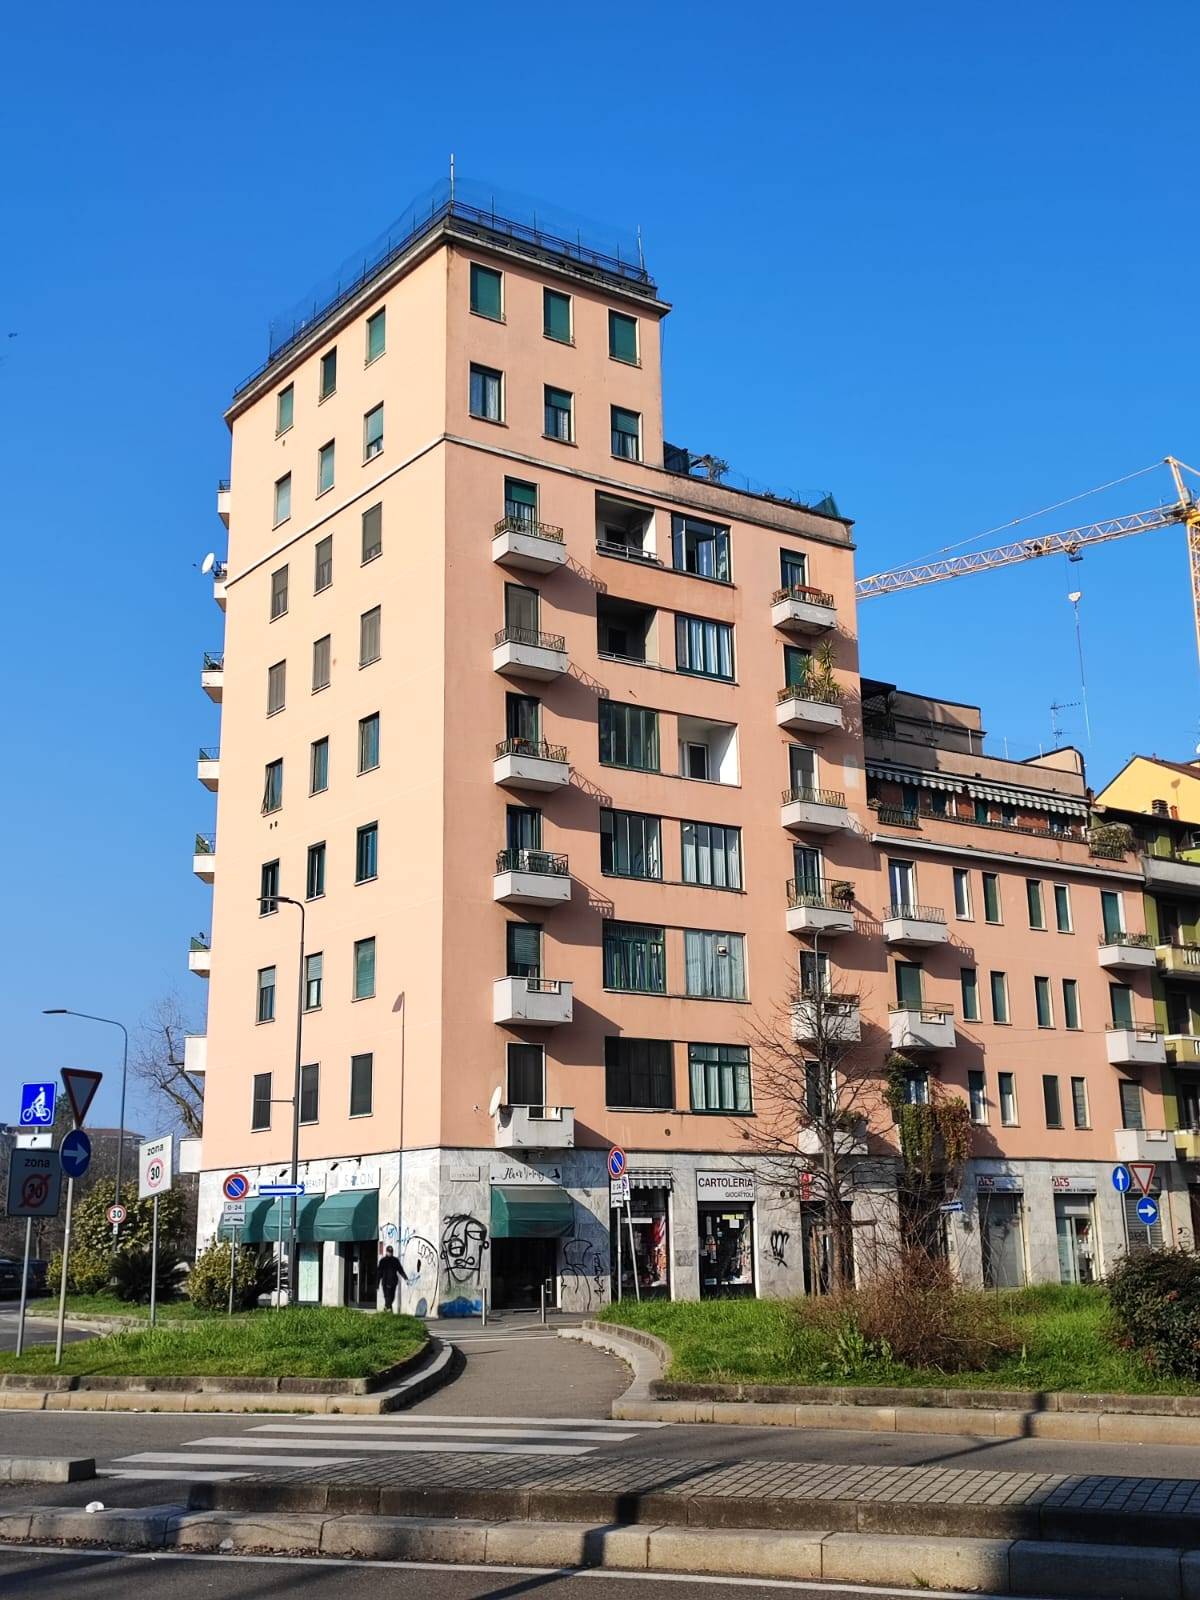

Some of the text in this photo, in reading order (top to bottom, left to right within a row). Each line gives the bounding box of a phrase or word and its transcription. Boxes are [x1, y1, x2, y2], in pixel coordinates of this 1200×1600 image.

[146, 1143, 164, 1156] zona
[24, 1158, 50, 1168] zona
[150, 1166, 160, 1180] 30
[698, 1177, 753, 1188] CARTOLERIA
[28, 1183, 43, 1199] 30
[112, 1209, 122, 1219] 30
